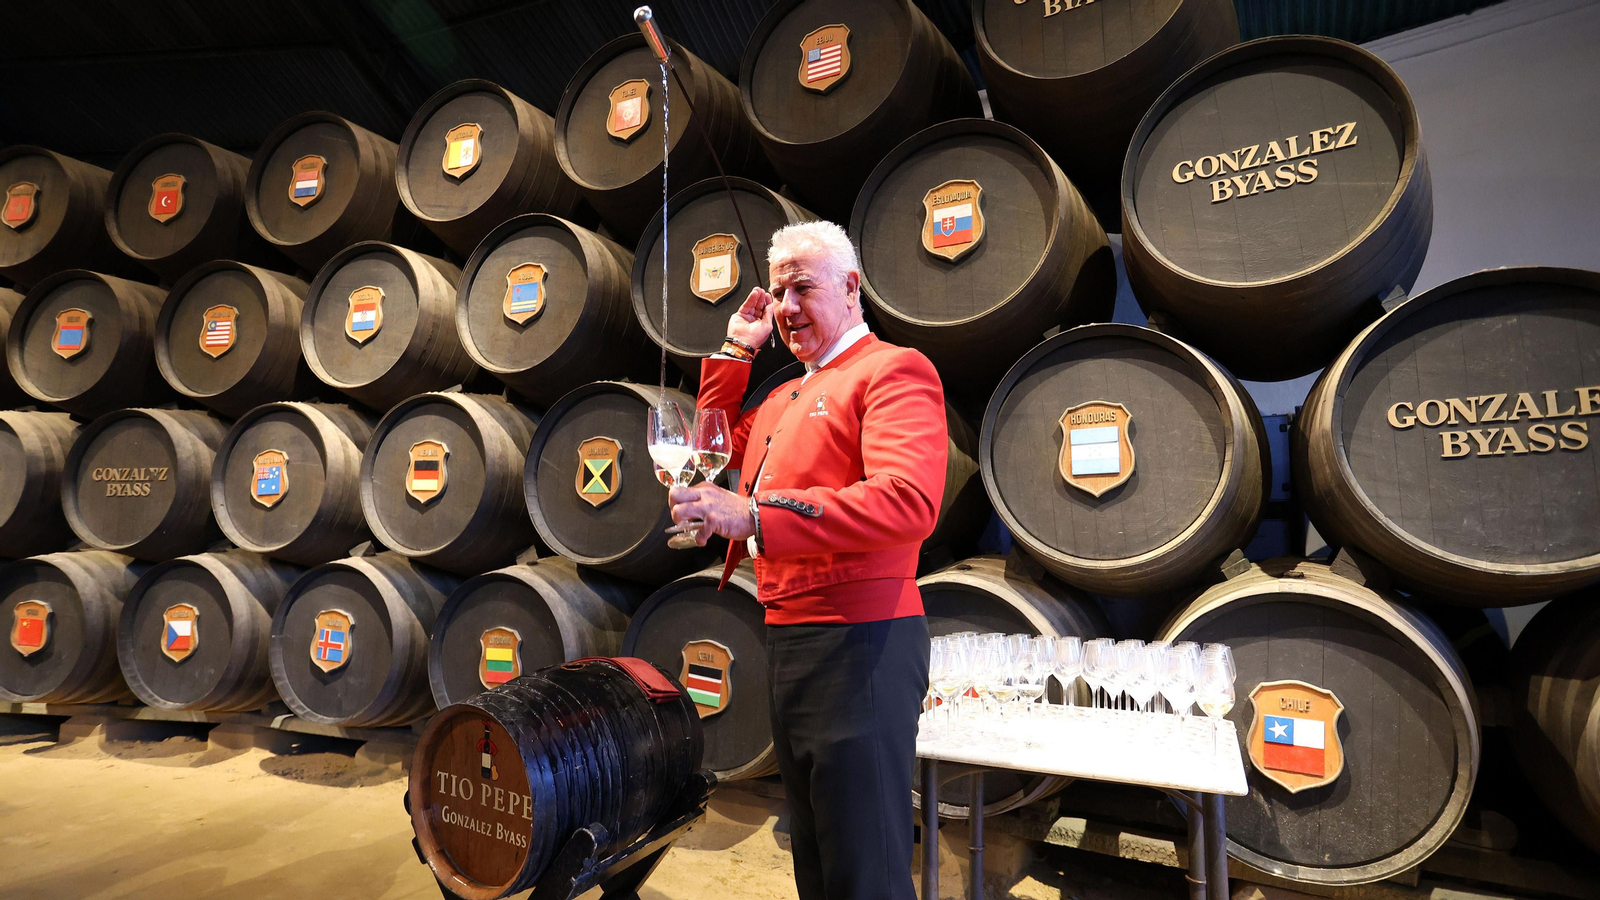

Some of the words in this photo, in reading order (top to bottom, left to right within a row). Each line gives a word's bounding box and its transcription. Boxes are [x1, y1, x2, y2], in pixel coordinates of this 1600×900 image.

[1171, 121, 1358, 184] GONZALEZ
[1210, 158, 1319, 203] BYASS
[932, 191, 973, 207] ESLOVAQUIA
[1070, 411, 1118, 426] HONDURAS
[1439, 421, 1590, 459] BYASS
[106, 482, 151, 497] BYASS
[1279, 698, 1311, 713] CHILE
[437, 770, 474, 801] TIO
[481, 783, 533, 821] PEPE
